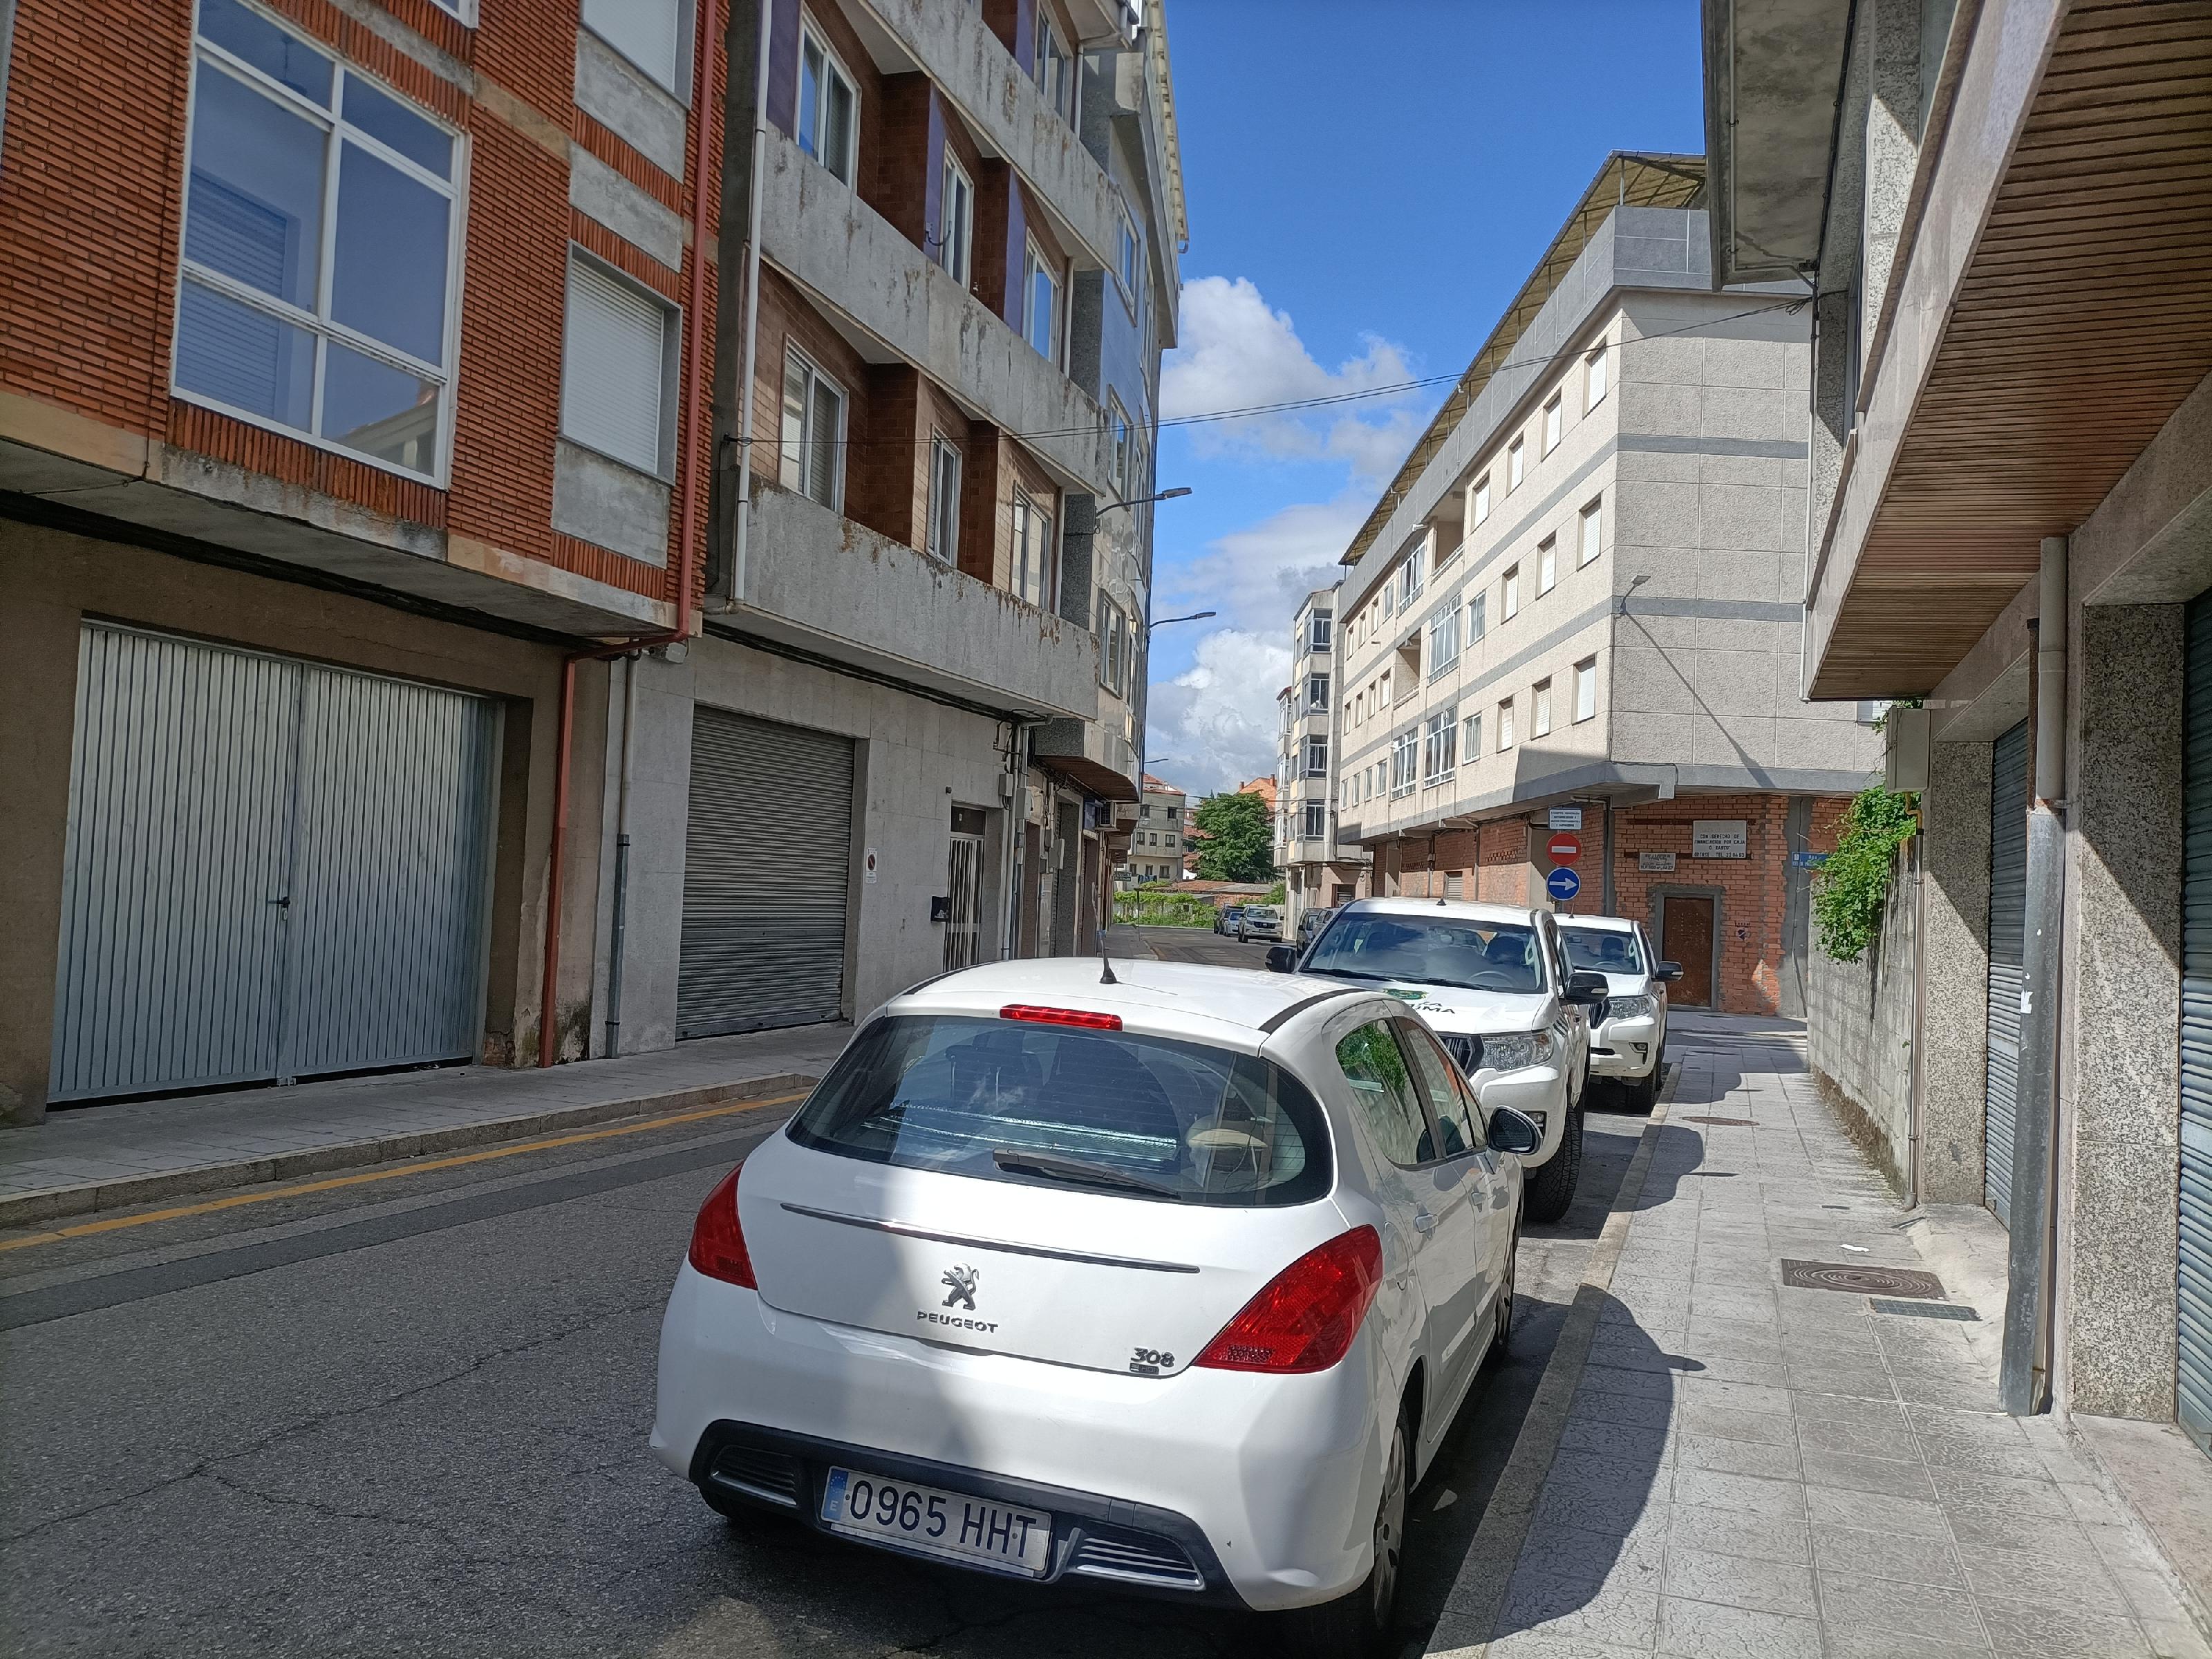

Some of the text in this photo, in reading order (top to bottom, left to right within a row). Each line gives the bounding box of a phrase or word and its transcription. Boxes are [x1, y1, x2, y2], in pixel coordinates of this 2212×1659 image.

[917, 1310, 999, 1333] PEUGEOT
[1130, 1347, 1175, 1367] 308
[830, 1501, 838, 1512] E
[850, 1480, 1037, 1558] 0965 HHT
